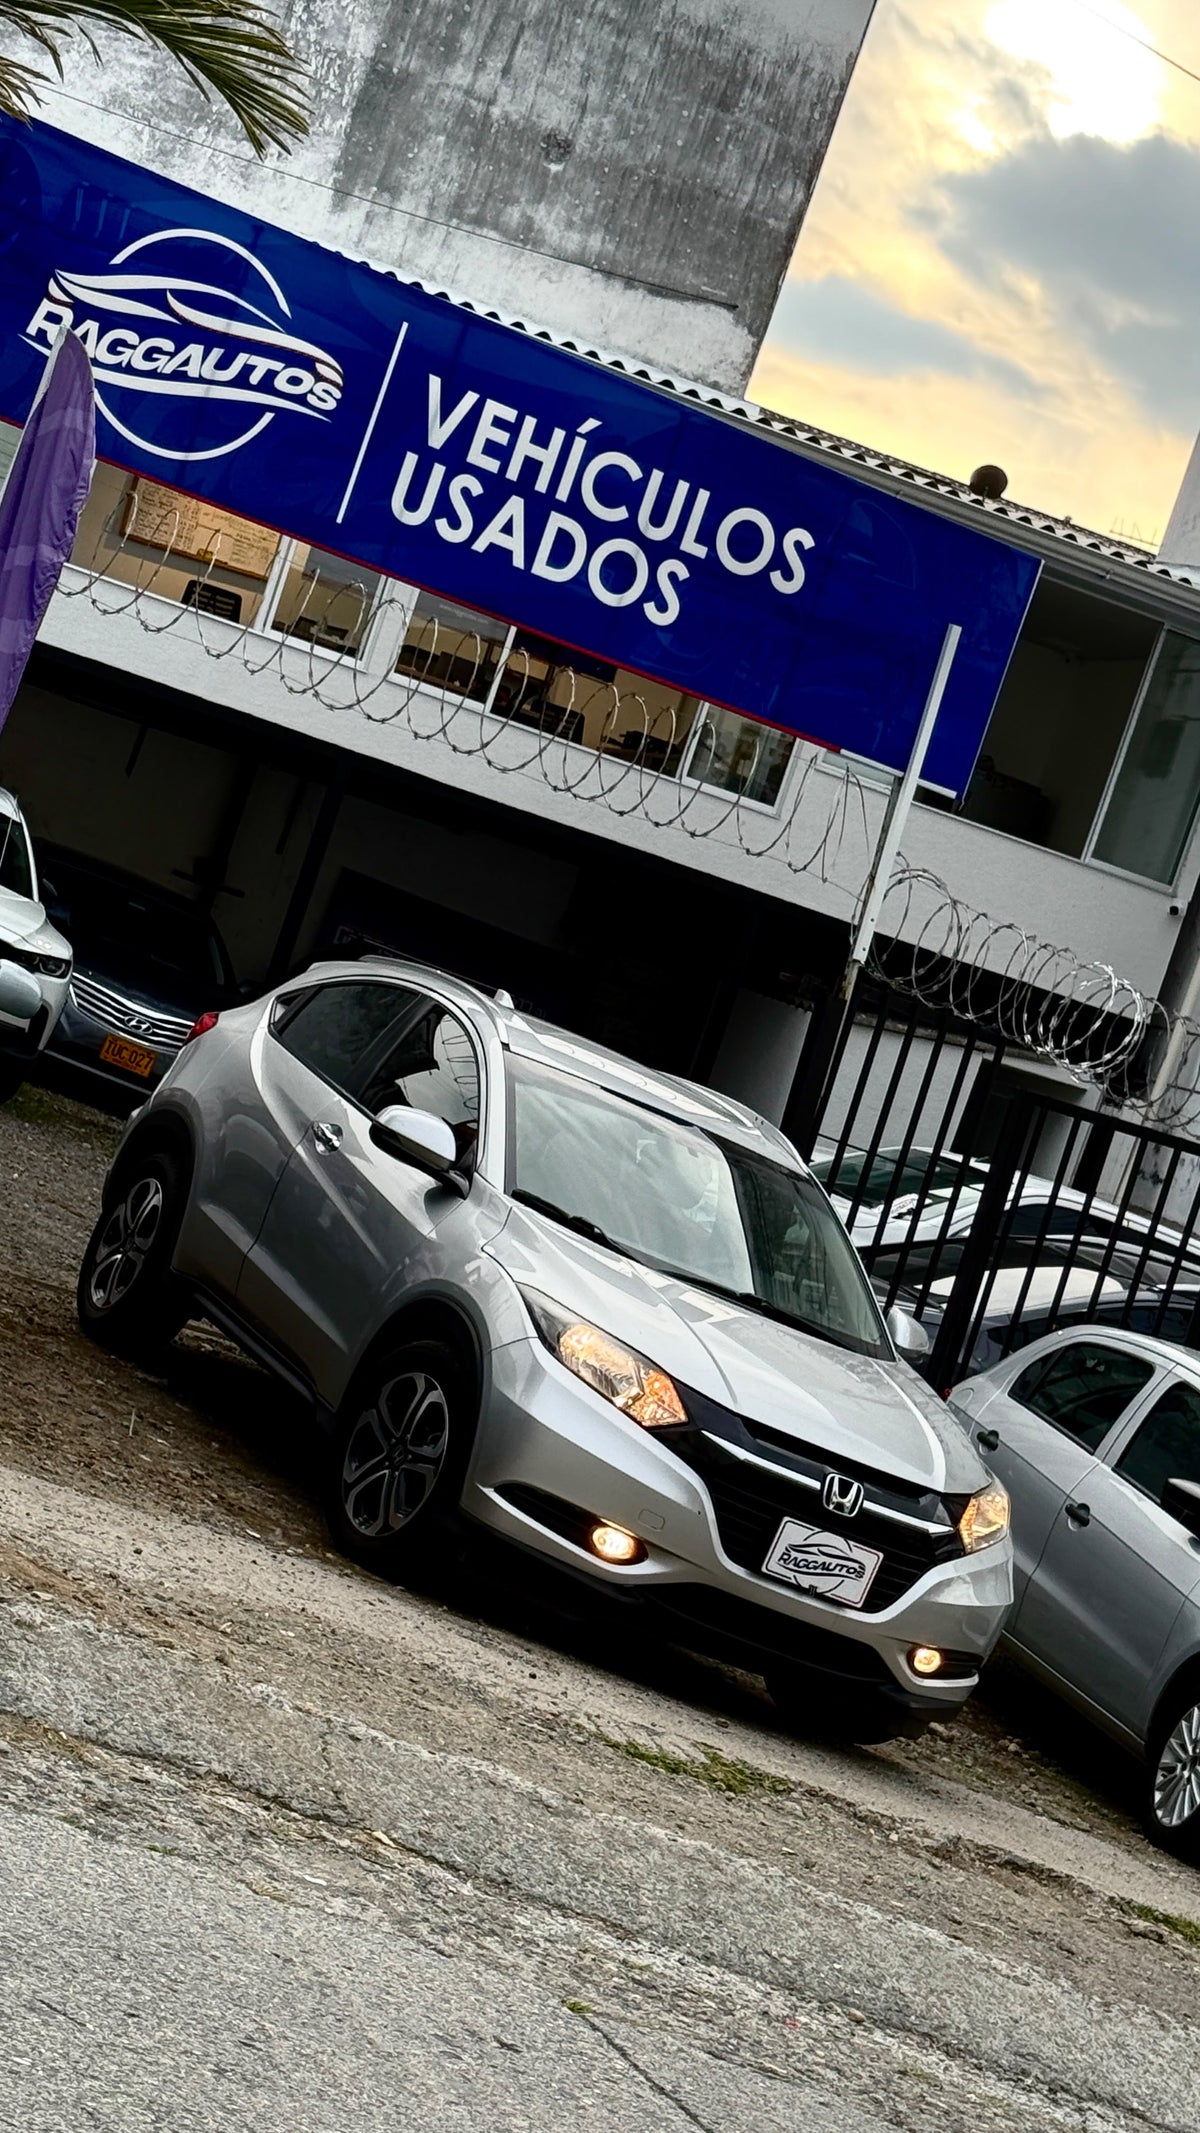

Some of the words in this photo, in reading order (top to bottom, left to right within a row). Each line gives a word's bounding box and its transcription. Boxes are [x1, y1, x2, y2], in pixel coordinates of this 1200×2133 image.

[25, 297, 342, 411] RAGGAUTOS
[391, 452, 690, 626] USADOS
[429, 374, 816, 595] VEHÍCULOS
[777, 1552, 866, 1579] RAGGAUTOS
